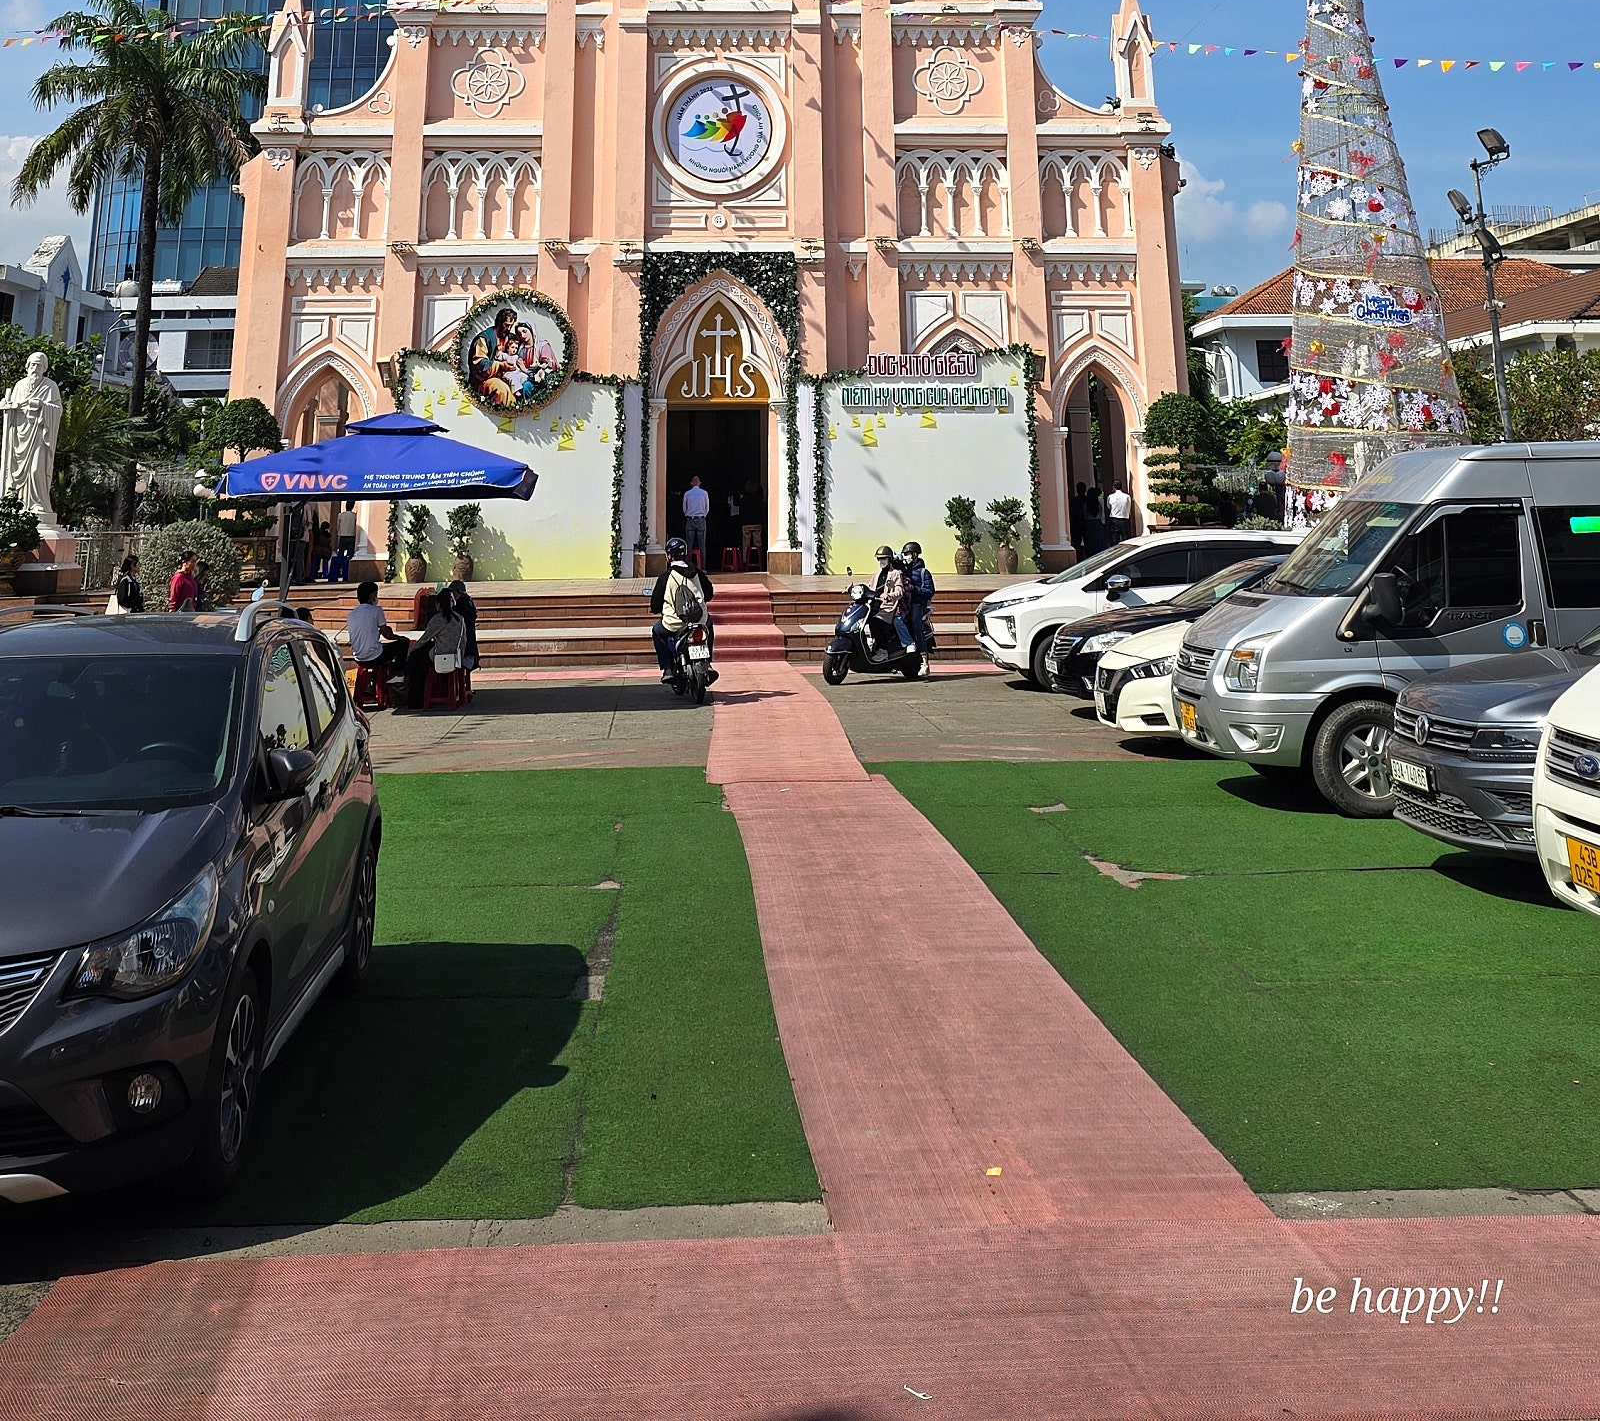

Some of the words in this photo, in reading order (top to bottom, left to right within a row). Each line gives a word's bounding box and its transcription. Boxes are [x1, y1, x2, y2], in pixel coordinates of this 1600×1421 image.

[1365, 294, 1395, 309] Merry
[874, 387, 890, 406] HY
[992, 387, 1008, 406] TA
[283, 474, 348, 490] VNVC
[1450, 610, 1492, 620] TRANSIT
[1577, 756, 1594, 774] Ford
[1579, 844, 1598, 870] 43B
